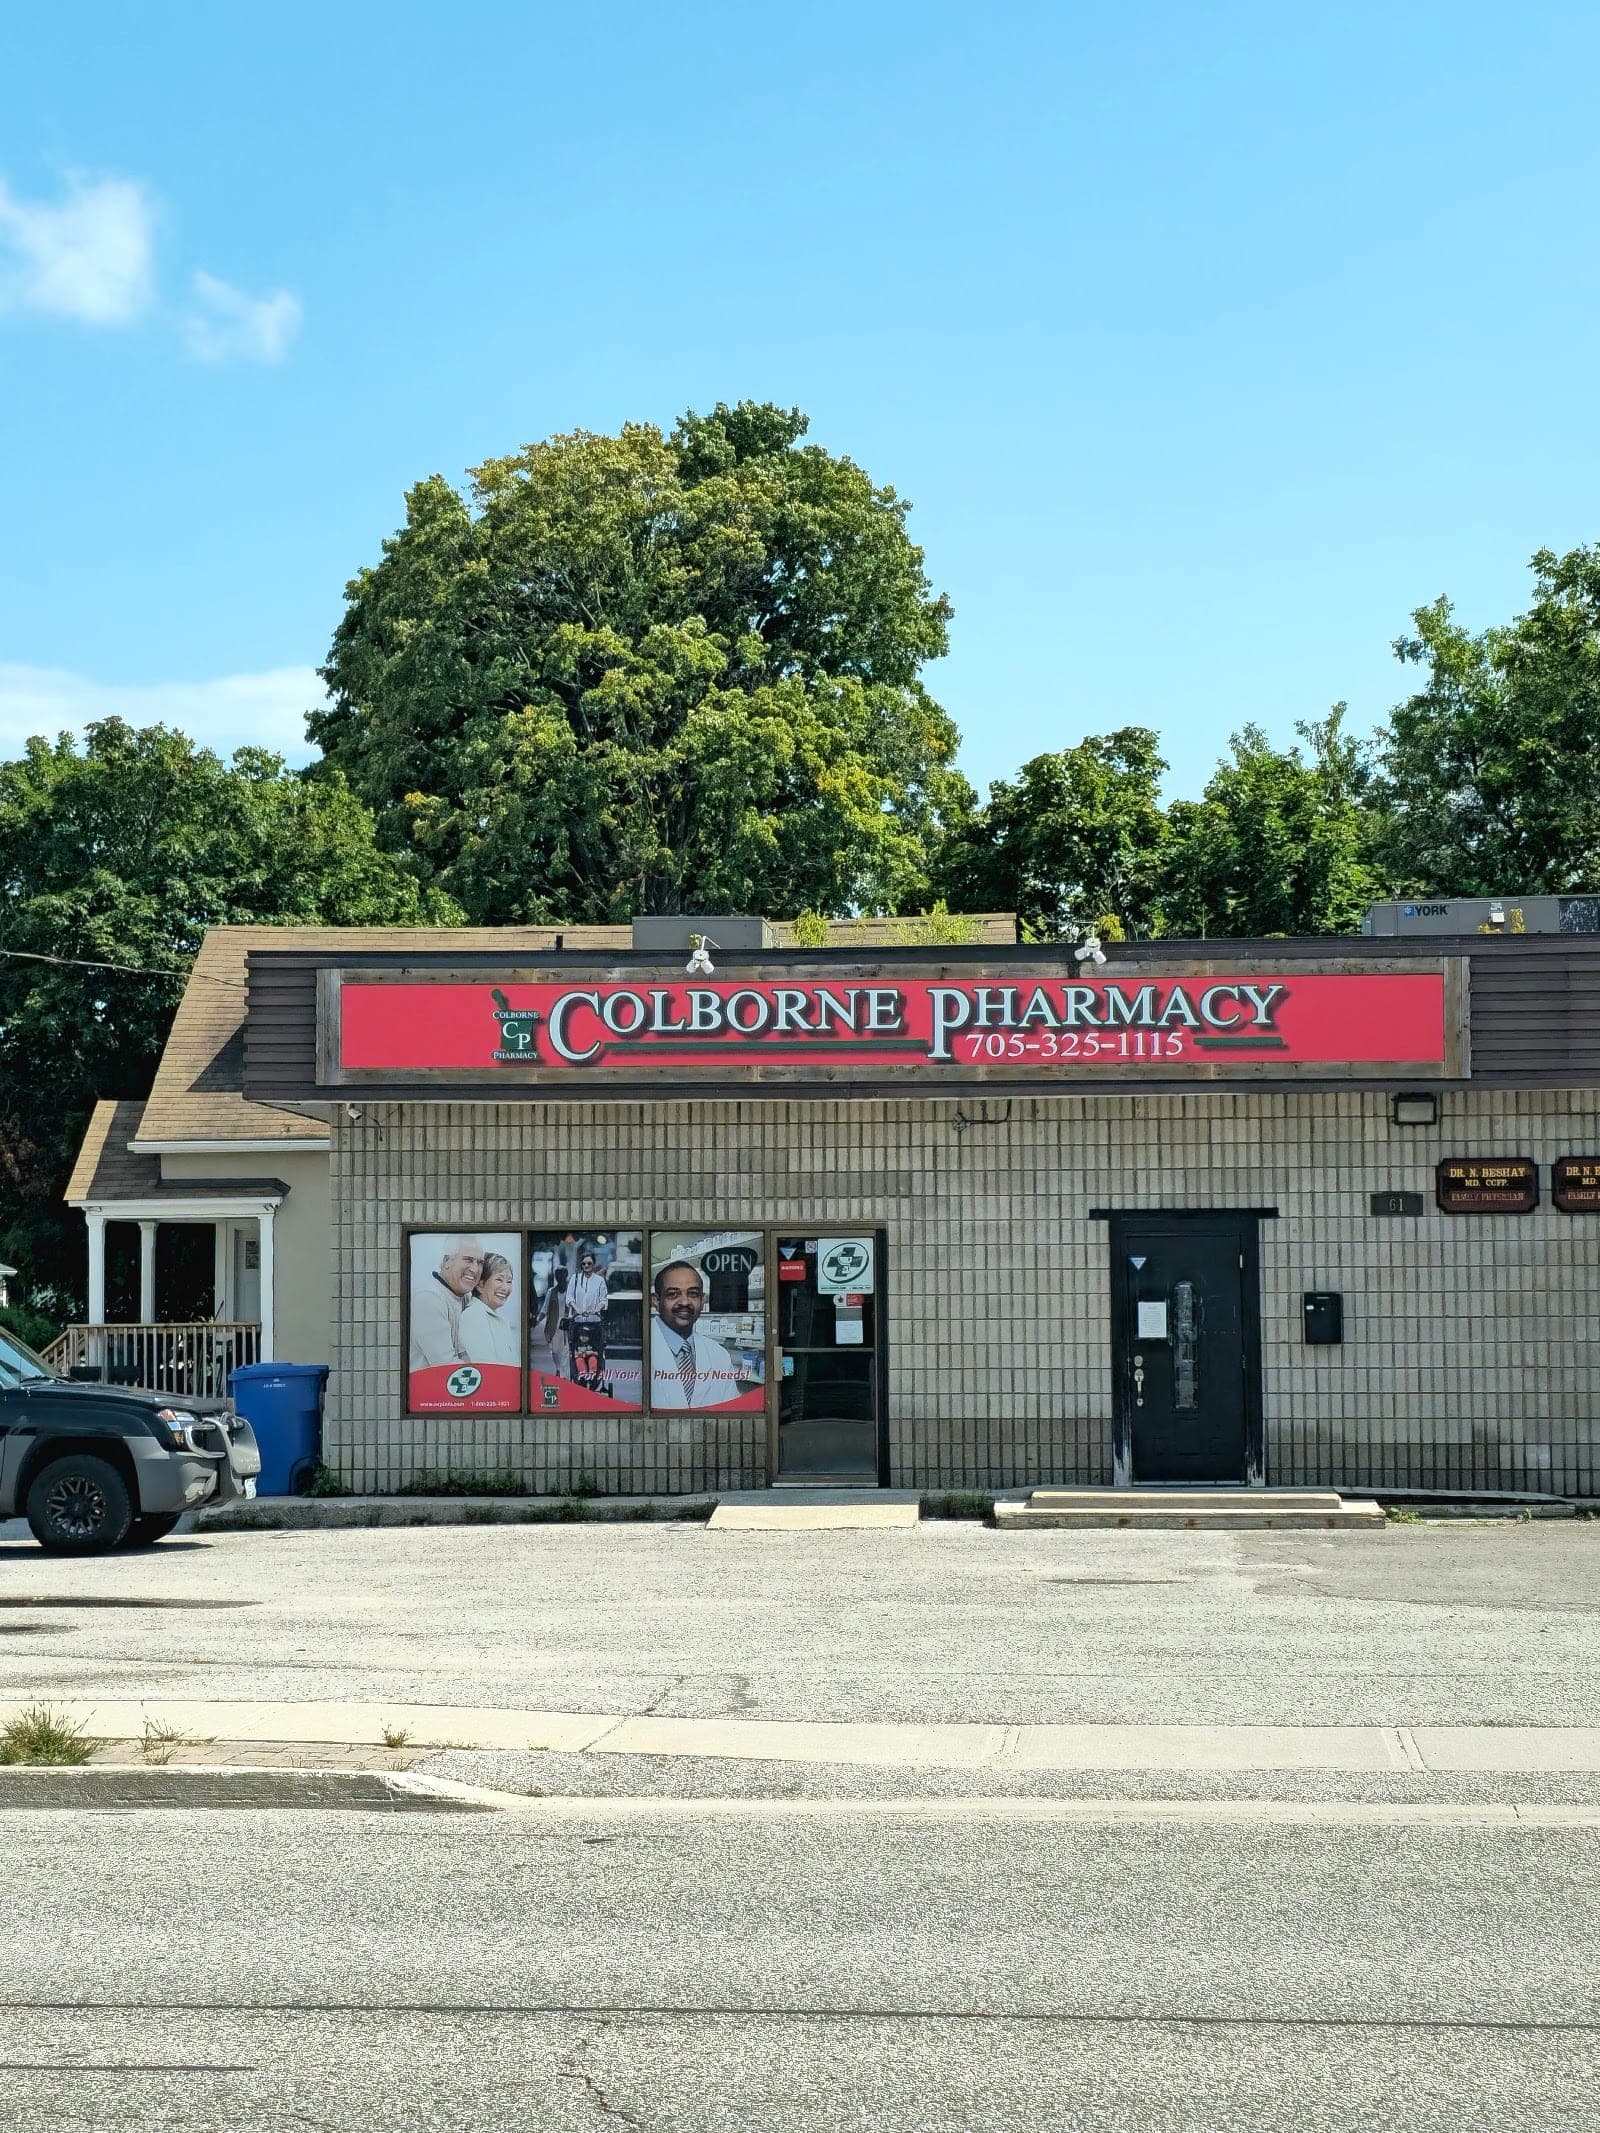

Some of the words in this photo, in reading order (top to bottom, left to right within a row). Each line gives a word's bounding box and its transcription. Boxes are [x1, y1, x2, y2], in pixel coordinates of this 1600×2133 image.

[1415, 905, 1448, 917] YORK
[492, 1010, 539, 1020] COLBORNE
[548, 989, 902, 1061] COLBORNE
[926, 985, 1284, 1059] PHARMACY
[965, 1032, 1184, 1058] 705-325-1115
[493, 1051, 538, 1060] PHARMACY
[1449, 1168, 1466, 1178] DR.
[1469, 1168, 1479, 1178] N.
[1481, 1167, 1527, 1178] BESHAY
[705, 1253, 752, 1272] OPEN
[577, 1369, 597, 1381] For
[599, 1368, 613, 1381] All
[615, 1369, 641, 1381] Your
[653, 1369, 710, 1384] Pharmacy
[711, 1368, 751, 1381] Needs!
